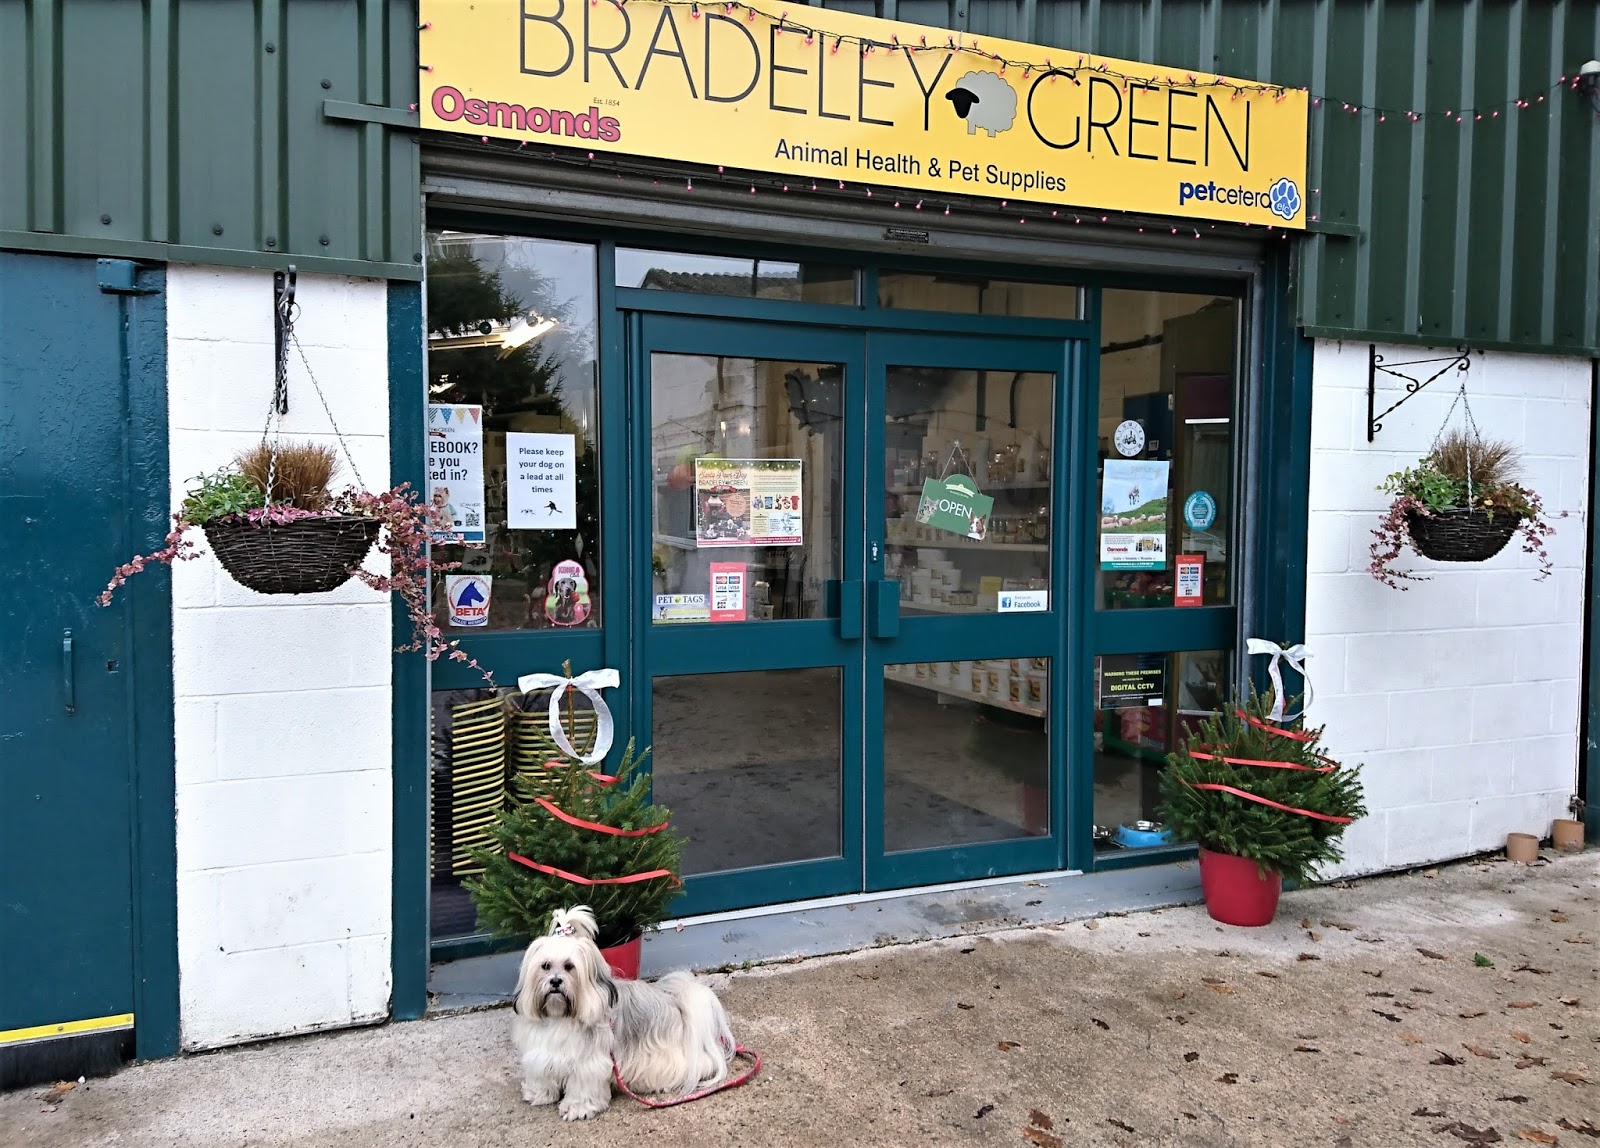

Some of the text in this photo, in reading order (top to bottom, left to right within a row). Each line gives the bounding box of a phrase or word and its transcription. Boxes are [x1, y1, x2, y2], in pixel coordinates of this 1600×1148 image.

[519, 0, 1251, 172] BRADELEY GREEN
[605, 99, 620, 107] 1854
[431, 85, 621, 143] Osmonds
[774, 138, 1067, 193] Animal Health & Pet Supplies
[1179, 181, 1273, 209] petcetera
[430, 441, 479, 454] EBOOK?
[518, 447, 565, 457] Please keep
[438, 457, 460, 469] you
[518, 461, 537, 469] your
[538, 460, 554, 470] dog
[450, 469, 468, 481] in?
[526, 472, 544, 481] lead
[554, 473, 564, 481] all
[531, 485, 553, 493] times
[939, 499, 973, 519] OPEN
[658, 595, 704, 604] PET TAGS
[1014, 600, 1041, 609] Facebook
[455, 607, 485, 616] BETA
